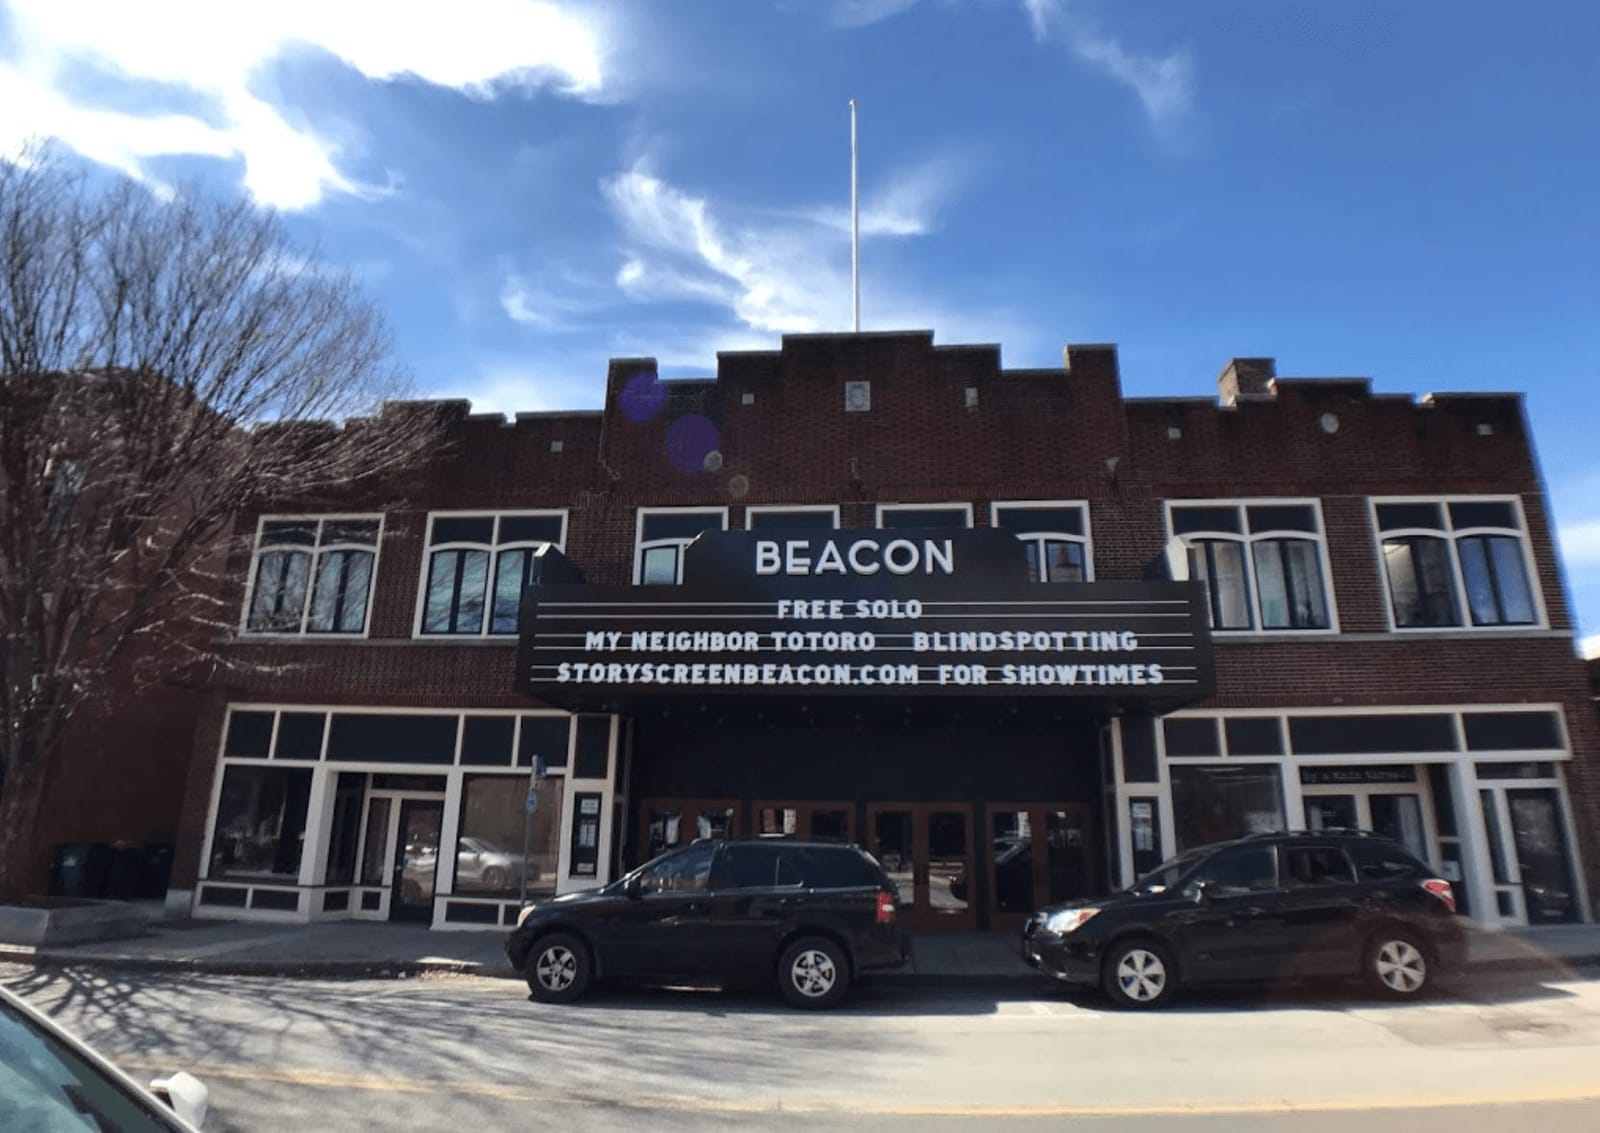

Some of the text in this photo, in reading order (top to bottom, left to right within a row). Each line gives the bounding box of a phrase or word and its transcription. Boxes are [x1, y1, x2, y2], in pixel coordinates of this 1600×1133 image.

[756, 539, 954, 574] BEACON
[777, 599, 923, 619] FREE SOLO
[584, 631, 1138, 652] MY NEIGHBOR TOTORO BLINDSPOTTING
[556, 662, 1164, 685] STORYSCREENBEACON.COM FOR SHOWTIMES
